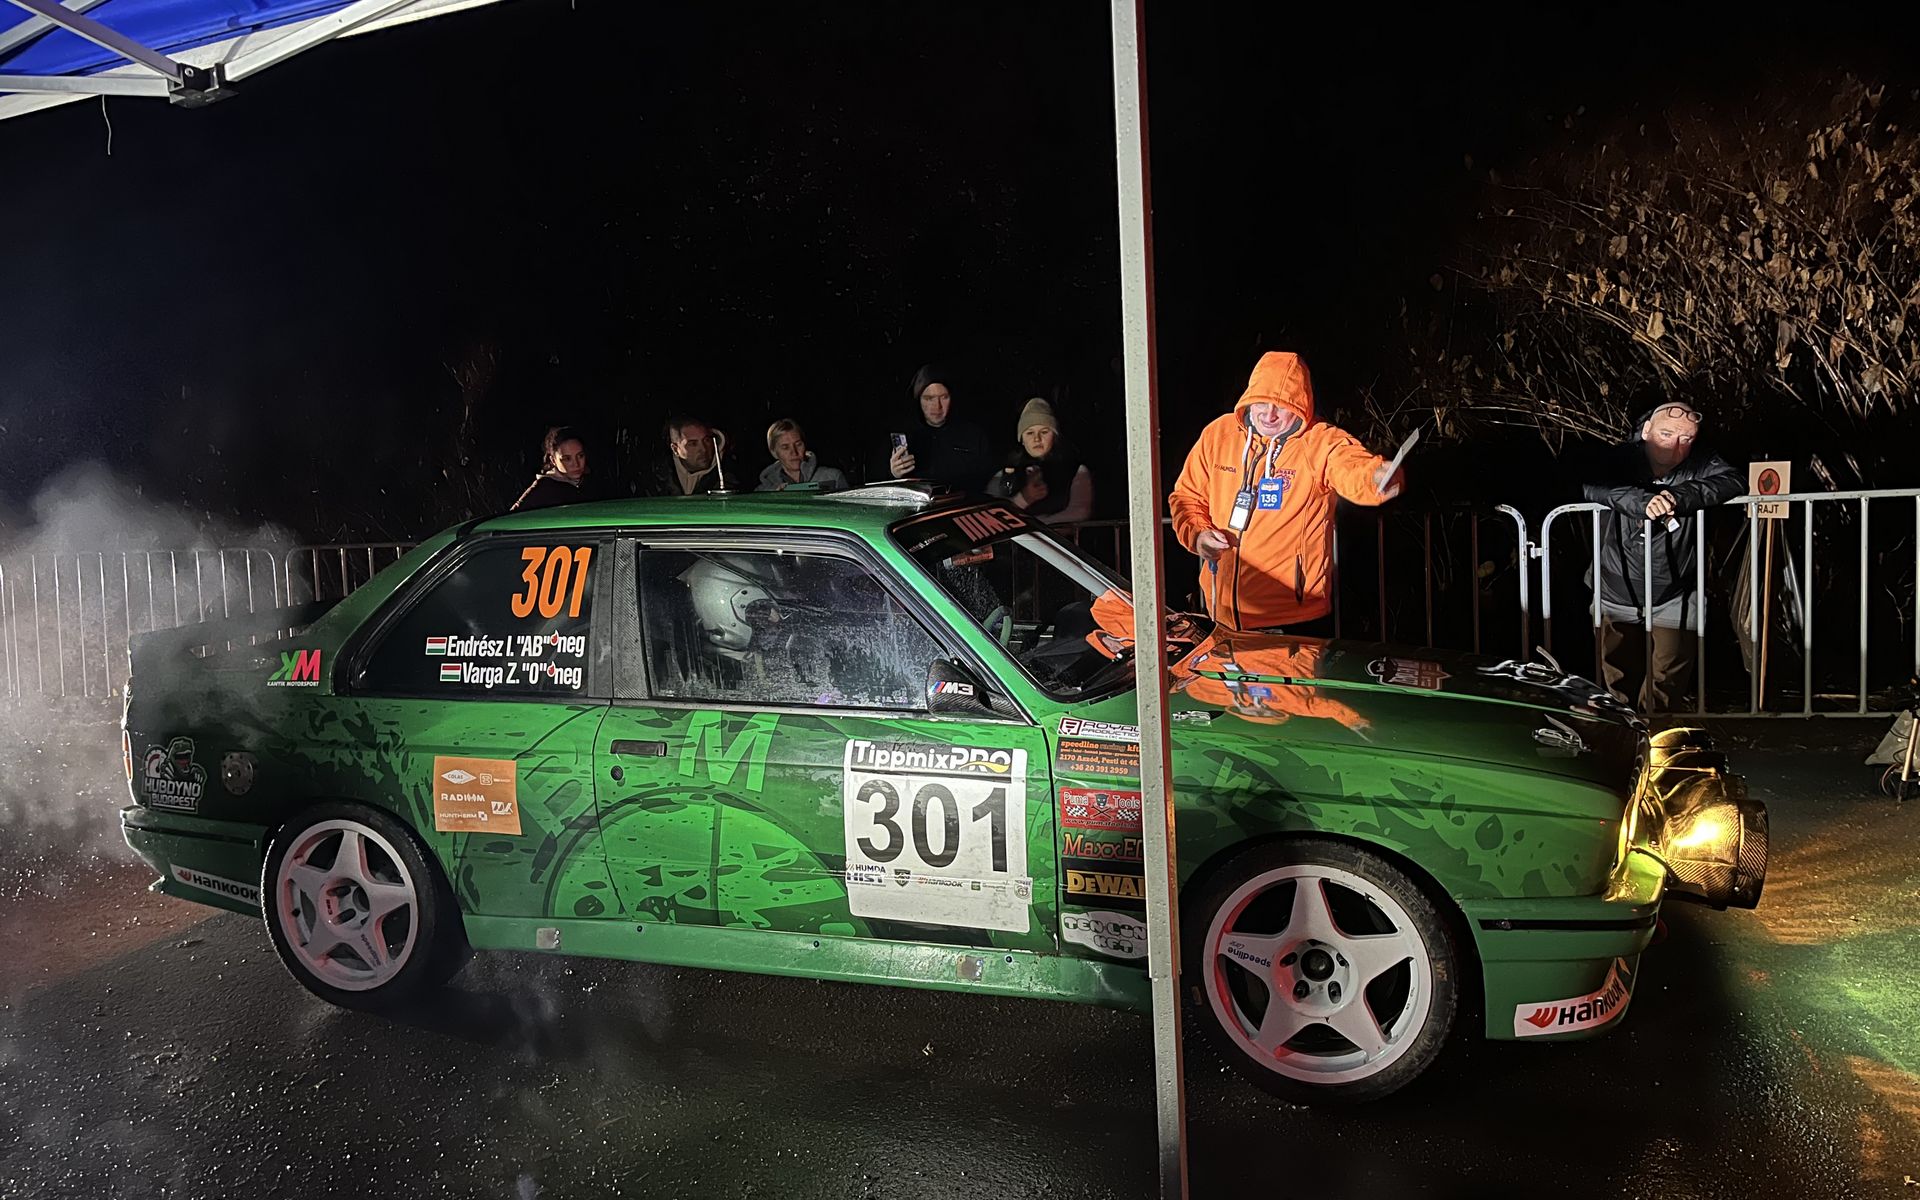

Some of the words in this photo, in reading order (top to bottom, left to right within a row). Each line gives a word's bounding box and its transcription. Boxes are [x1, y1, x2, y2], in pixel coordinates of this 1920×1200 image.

[1261, 494, 1278, 503] 136
[1757, 504, 1779, 514] RAJT
[511, 546, 592, 618] 301
[447, 634, 504, 657] Endrész
[557, 636, 586, 657] neg
[463, 662, 504, 688] Varga
[506, 663, 520, 684] Z.
[553, 666, 582, 689] neg
[1083, 721, 1140, 733] ROYAL
[1109, 766, 1129, 774] 2959
[144, 777, 201, 798] HUBDYNO
[151, 792, 196, 807] BUDAPEST
[856, 779, 1008, 873] 301
[856, 864, 886, 873] HUMDA
[1227, 946, 1271, 968] speedline
